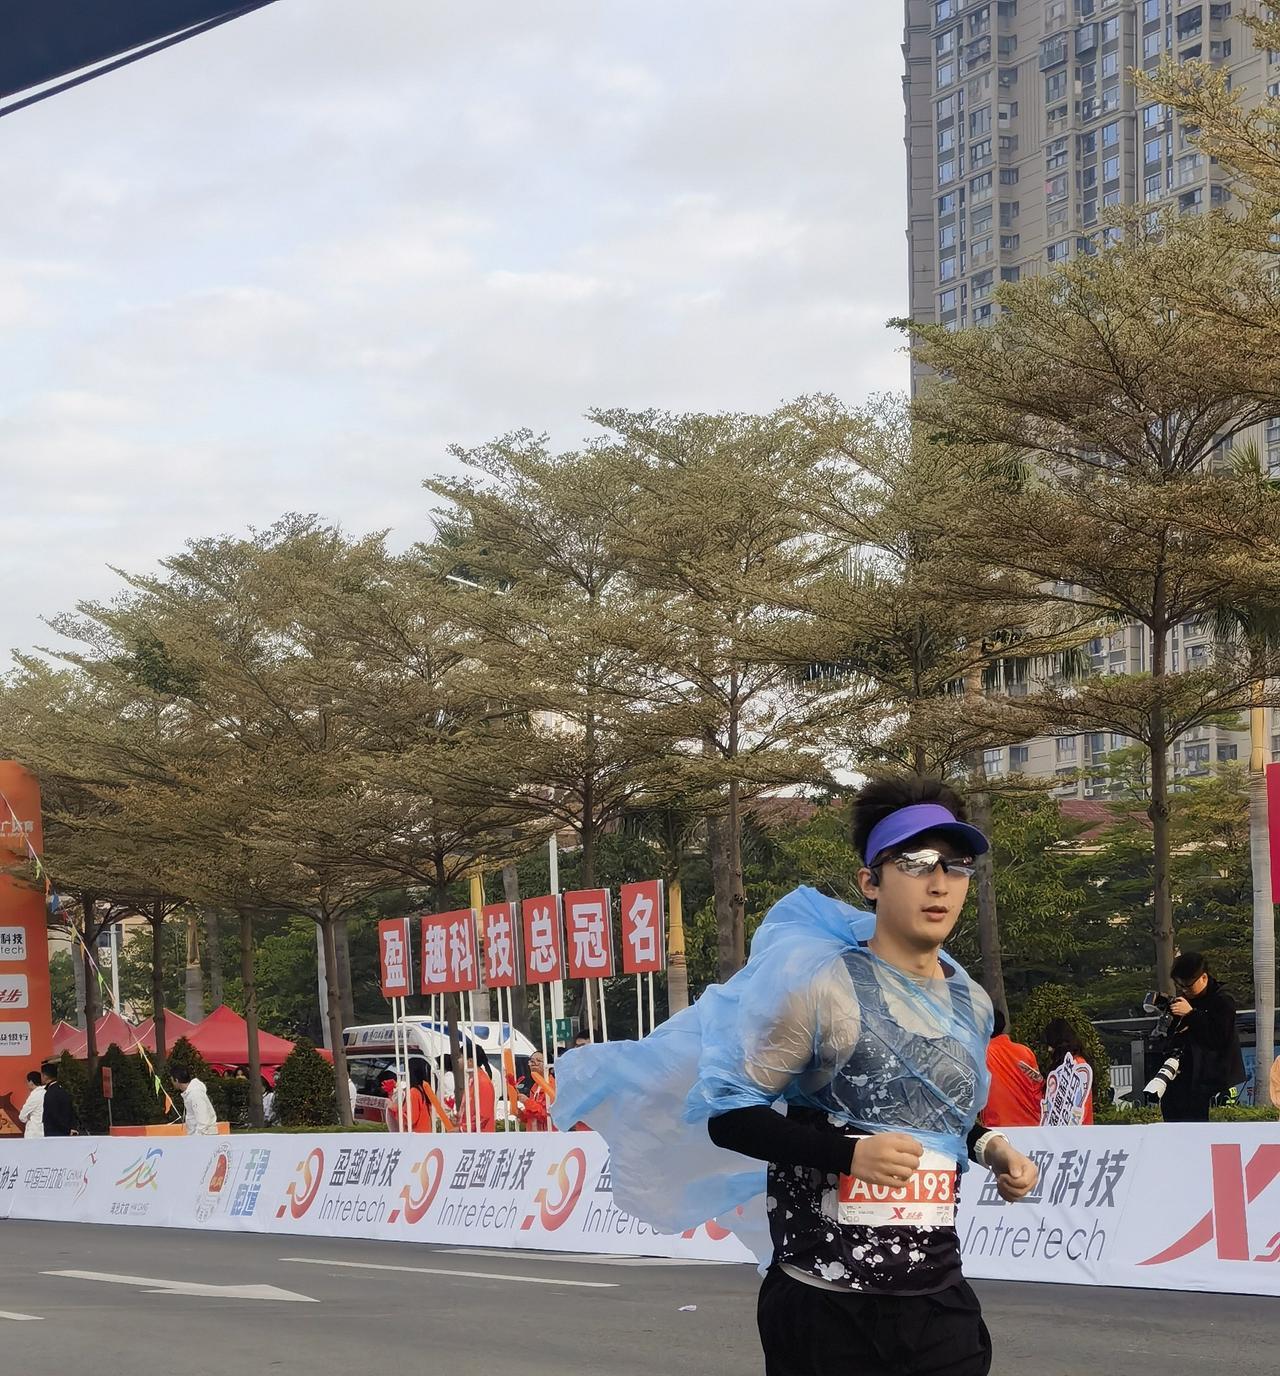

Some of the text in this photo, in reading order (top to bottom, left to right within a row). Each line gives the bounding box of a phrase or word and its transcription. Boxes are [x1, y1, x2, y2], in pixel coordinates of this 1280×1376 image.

[329, 1147, 401, 1187] 盈趣科技
[449, 1147, 536, 1191] 盈趣科技
[318, 1192, 387, 1224] Intretech
[436, 1196, 519, 1229] Intretech
[960, 1215, 1107, 1261] Intretech
